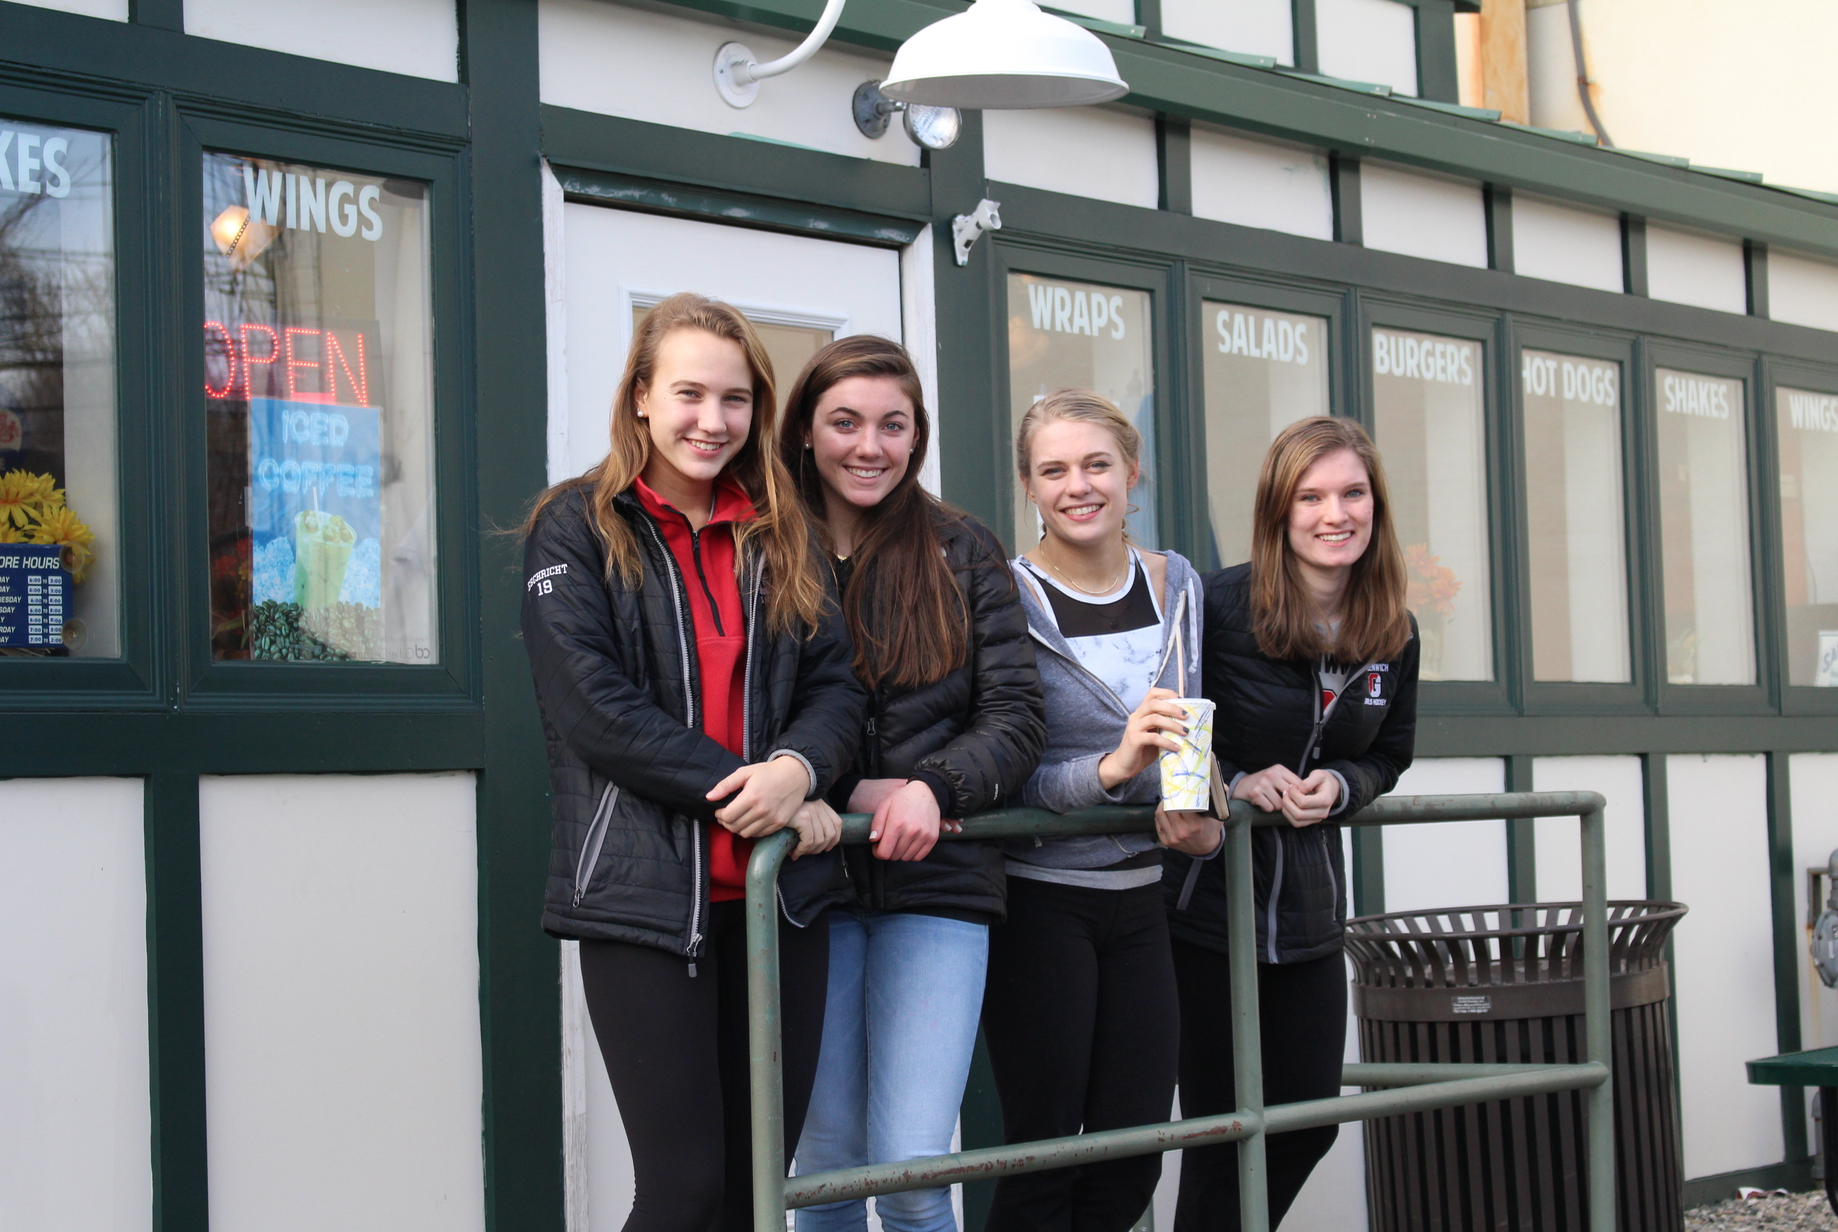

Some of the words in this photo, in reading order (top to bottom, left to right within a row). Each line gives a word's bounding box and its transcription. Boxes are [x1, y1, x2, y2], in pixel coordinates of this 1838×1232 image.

[244, 166, 384, 241] WINGS
[1028, 283, 1126, 340] WRAPS
[1216, 309, 1309, 365] SALADS
[1374, 333, 1472, 386] BURGERS
[203, 321, 369, 408] OPEN
[1522, 355, 1558, 398] HOT
[1562, 361, 1616, 407] DOGS
[1664, 375, 1730, 420] SHAKES
[1789, 394, 1838, 433] WINGS
[281, 409, 349, 447] ICED
[258, 458, 374, 498] COFFEE
[22, 556, 60, 570] HOURS
[537, 579, 553, 597] 19
[1368, 673, 1381, 697] G
